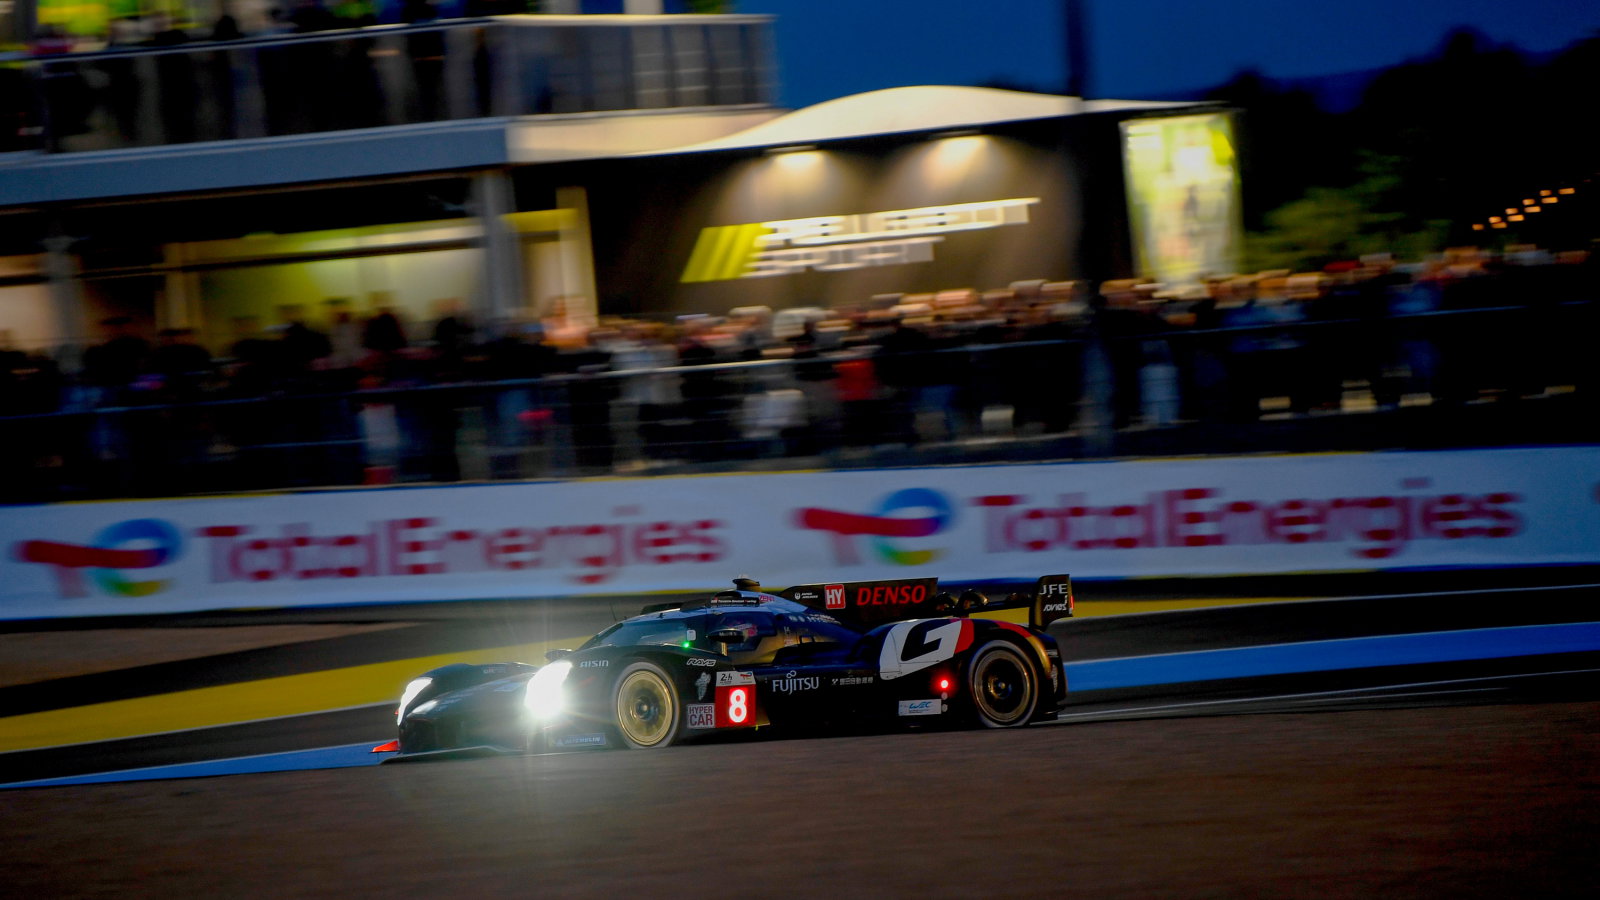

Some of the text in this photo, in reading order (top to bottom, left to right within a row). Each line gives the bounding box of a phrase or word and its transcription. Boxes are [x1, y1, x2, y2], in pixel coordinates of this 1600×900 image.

[969, 477, 1523, 559] TotalEnergies
[197, 507, 727, 585] TotalEnergies
[826, 588, 843, 605] HY
[856, 584, 927, 606] DENSO
[1038, 583, 1068, 595] JFE
[580, 660, 609, 668] AISIN
[686, 658, 717, 668] RAYS
[771, 675, 820, 696] FUJITSU
[689, 705, 713, 714] HYPER
[729, 688, 747, 723] 8
[689, 714, 713, 726] CAR
